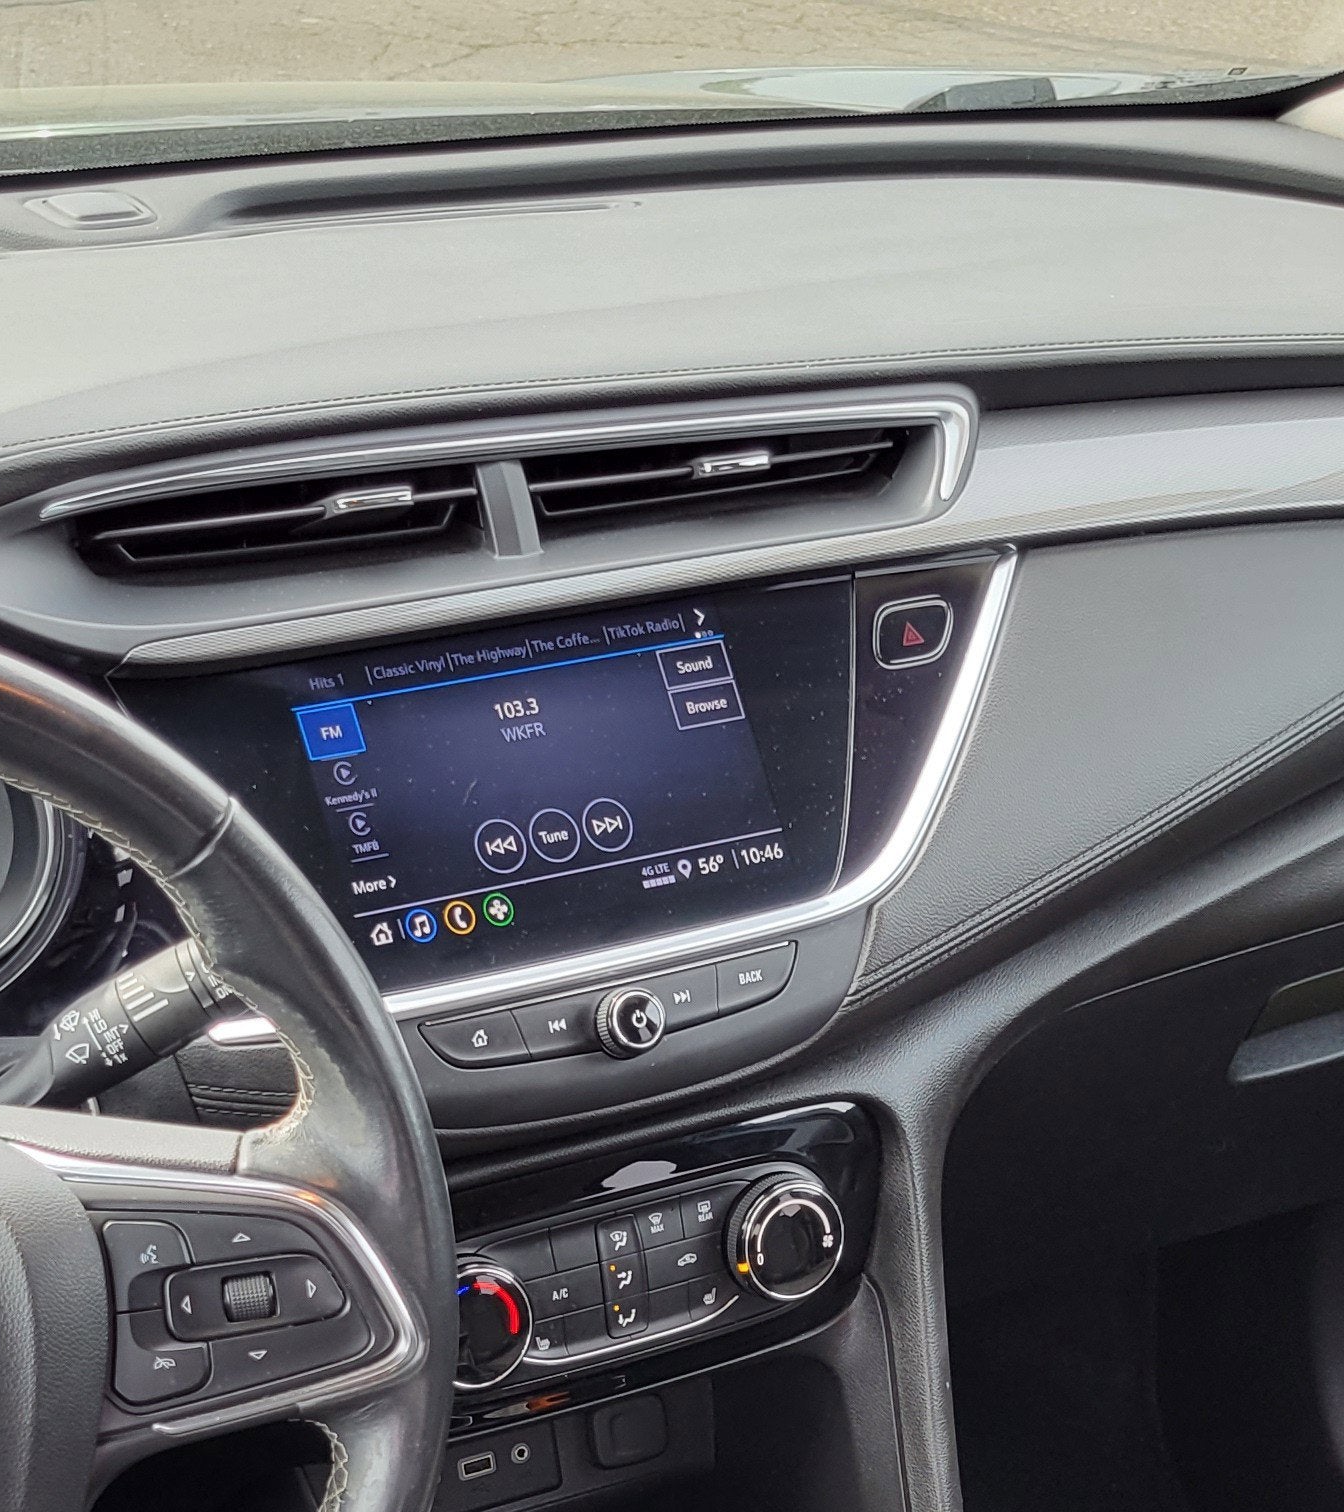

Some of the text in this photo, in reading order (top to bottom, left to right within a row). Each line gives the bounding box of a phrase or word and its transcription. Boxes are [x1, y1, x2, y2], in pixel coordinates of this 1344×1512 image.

[608, 618, 680, 641] TikTok Radio
[531, 638, 555, 653] The
[453, 645, 526, 667] The Highway
[676, 655, 713, 674] Sound
[373, 656, 446, 680] Classic Vinyl
[309, 672, 345, 691] Hits 1
[493, 697, 539, 720] 103.3
[685, 697, 728, 715] Browse
[320, 725, 343, 741] FM
[500, 721, 547, 743] WKFR
[538, 829, 569, 845] Tune
[741, 843, 784, 867] 10:46
[641, 861, 671, 877] 4G LTE
[351, 878, 387, 895] More
[738, 968, 763, 986] BACK
[88, 1008, 101, 1023] HI
[93, 1019, 107, 1034] LO
[103, 1025, 121, 1044] INT
[106, 1037, 124, 1055] OFF
[650, 1223, 665, 1234] MAX
[552, 1287, 569, 1301] A/C
